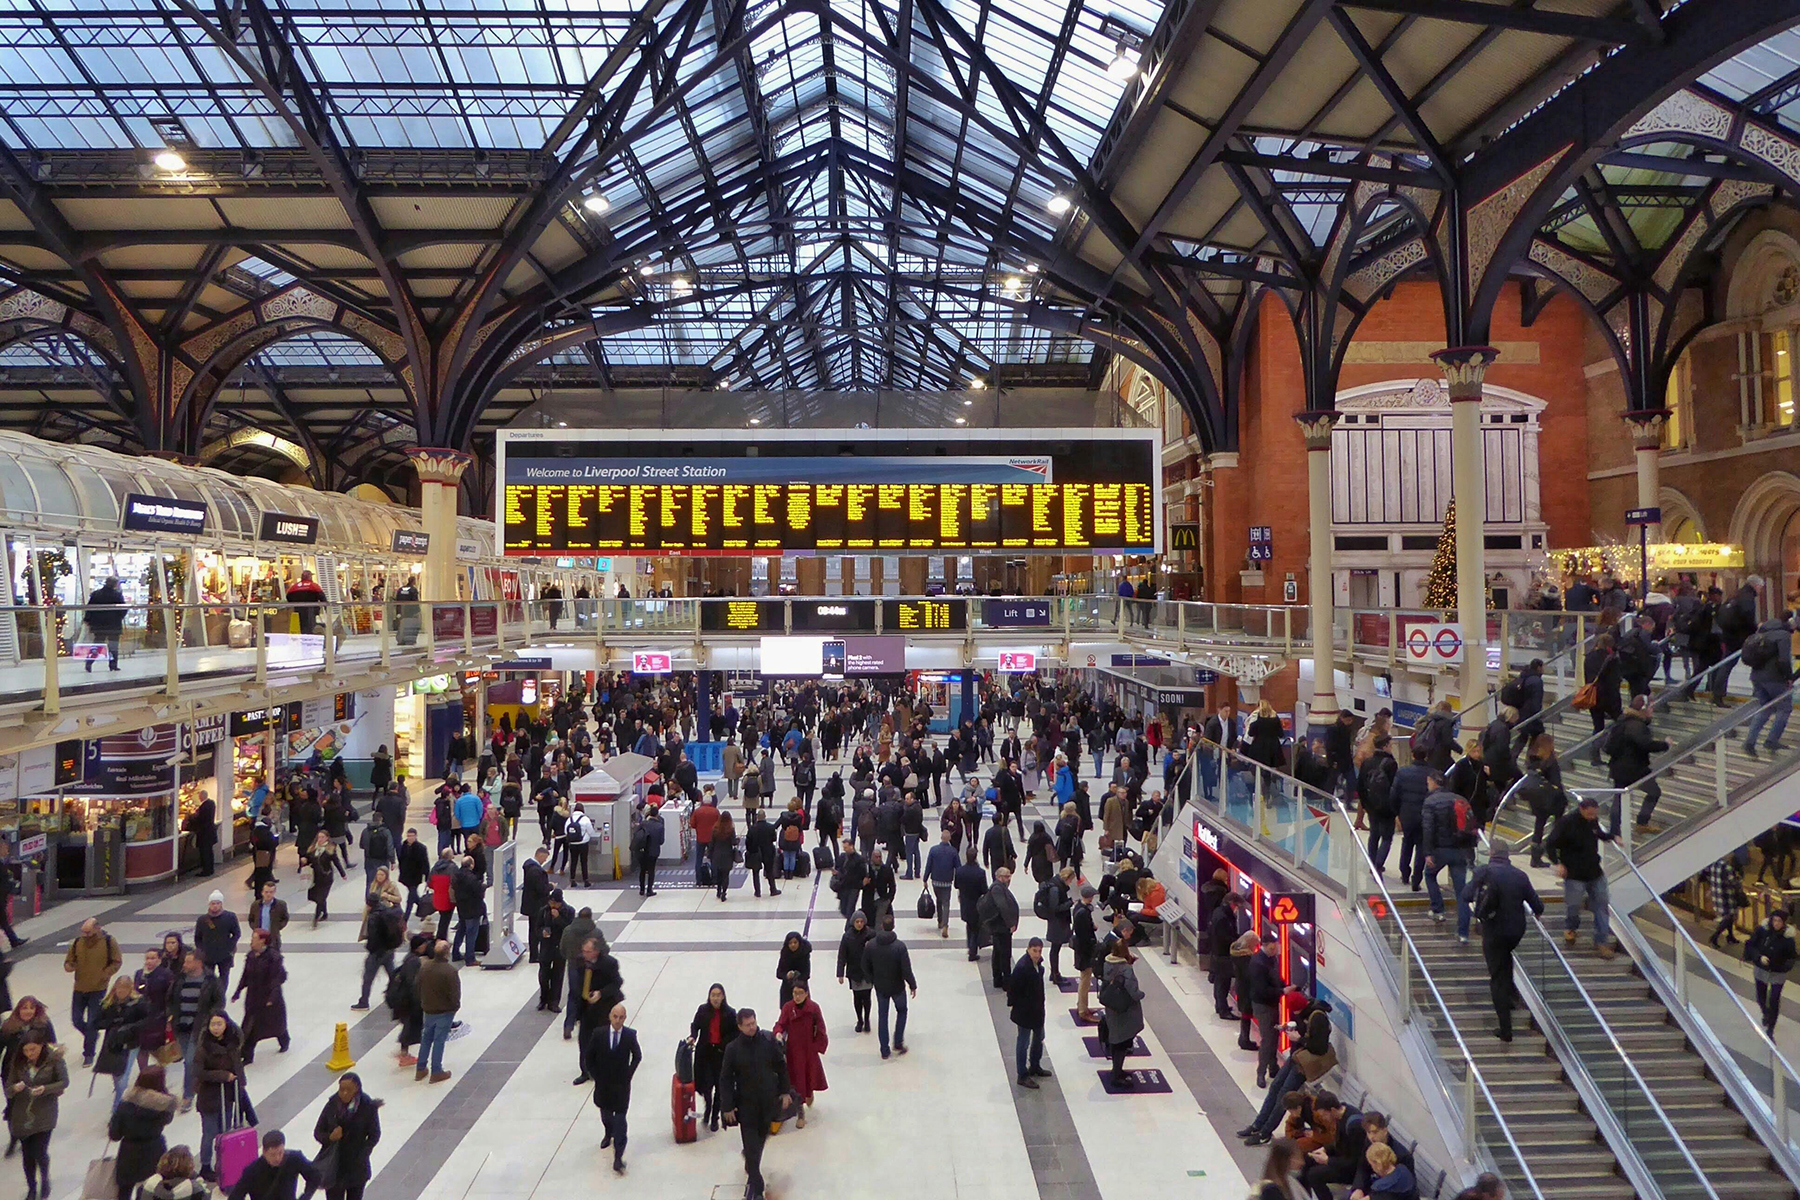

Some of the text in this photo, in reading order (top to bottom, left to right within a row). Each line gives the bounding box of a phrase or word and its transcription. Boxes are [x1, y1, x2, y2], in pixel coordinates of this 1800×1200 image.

[509, 431, 544, 439] Departures
[526, 465, 727, 480] Welcome to Liverpool Street Station
[276, 521, 299, 536] LUSH
[1004, 609, 1019, 618] Lift
[1160, 693, 1185, 704] SOON!
[88, 740, 98, 760] 5
